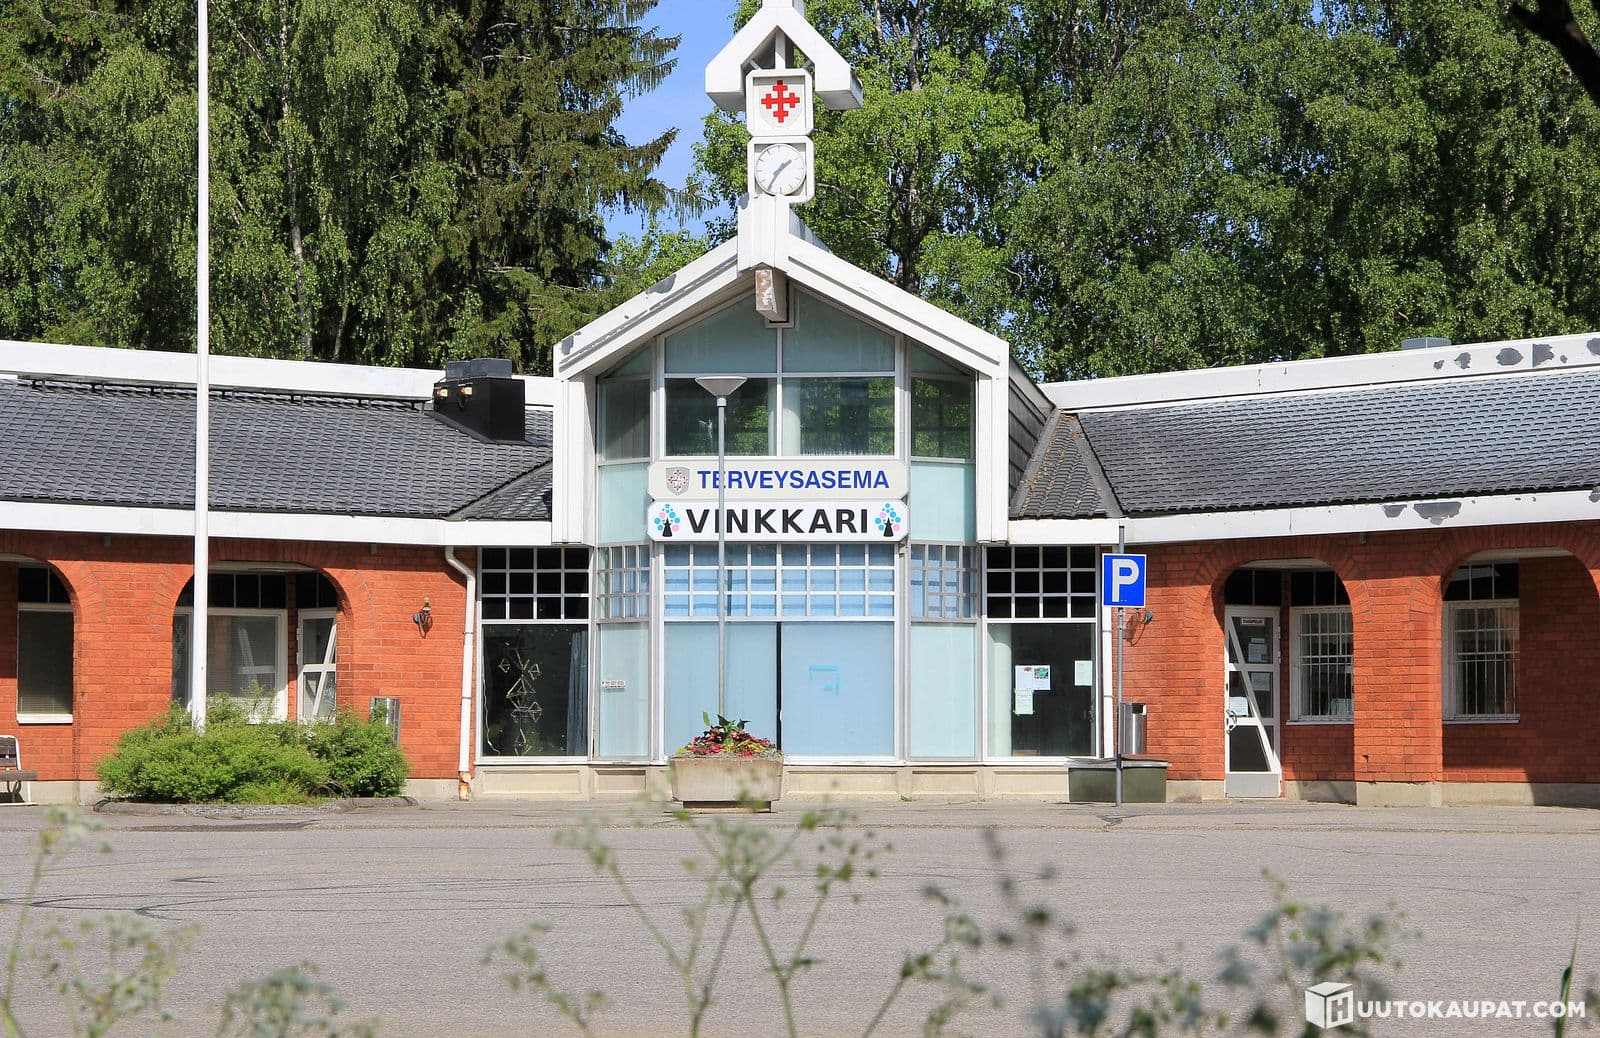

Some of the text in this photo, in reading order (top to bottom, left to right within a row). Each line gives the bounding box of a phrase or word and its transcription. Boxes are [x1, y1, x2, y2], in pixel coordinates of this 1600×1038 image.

[697, 470, 890, 489] TERVEYSASEMA
[685, 508, 868, 534] VINKKARI
[1112, 558, 1140, 603] P
